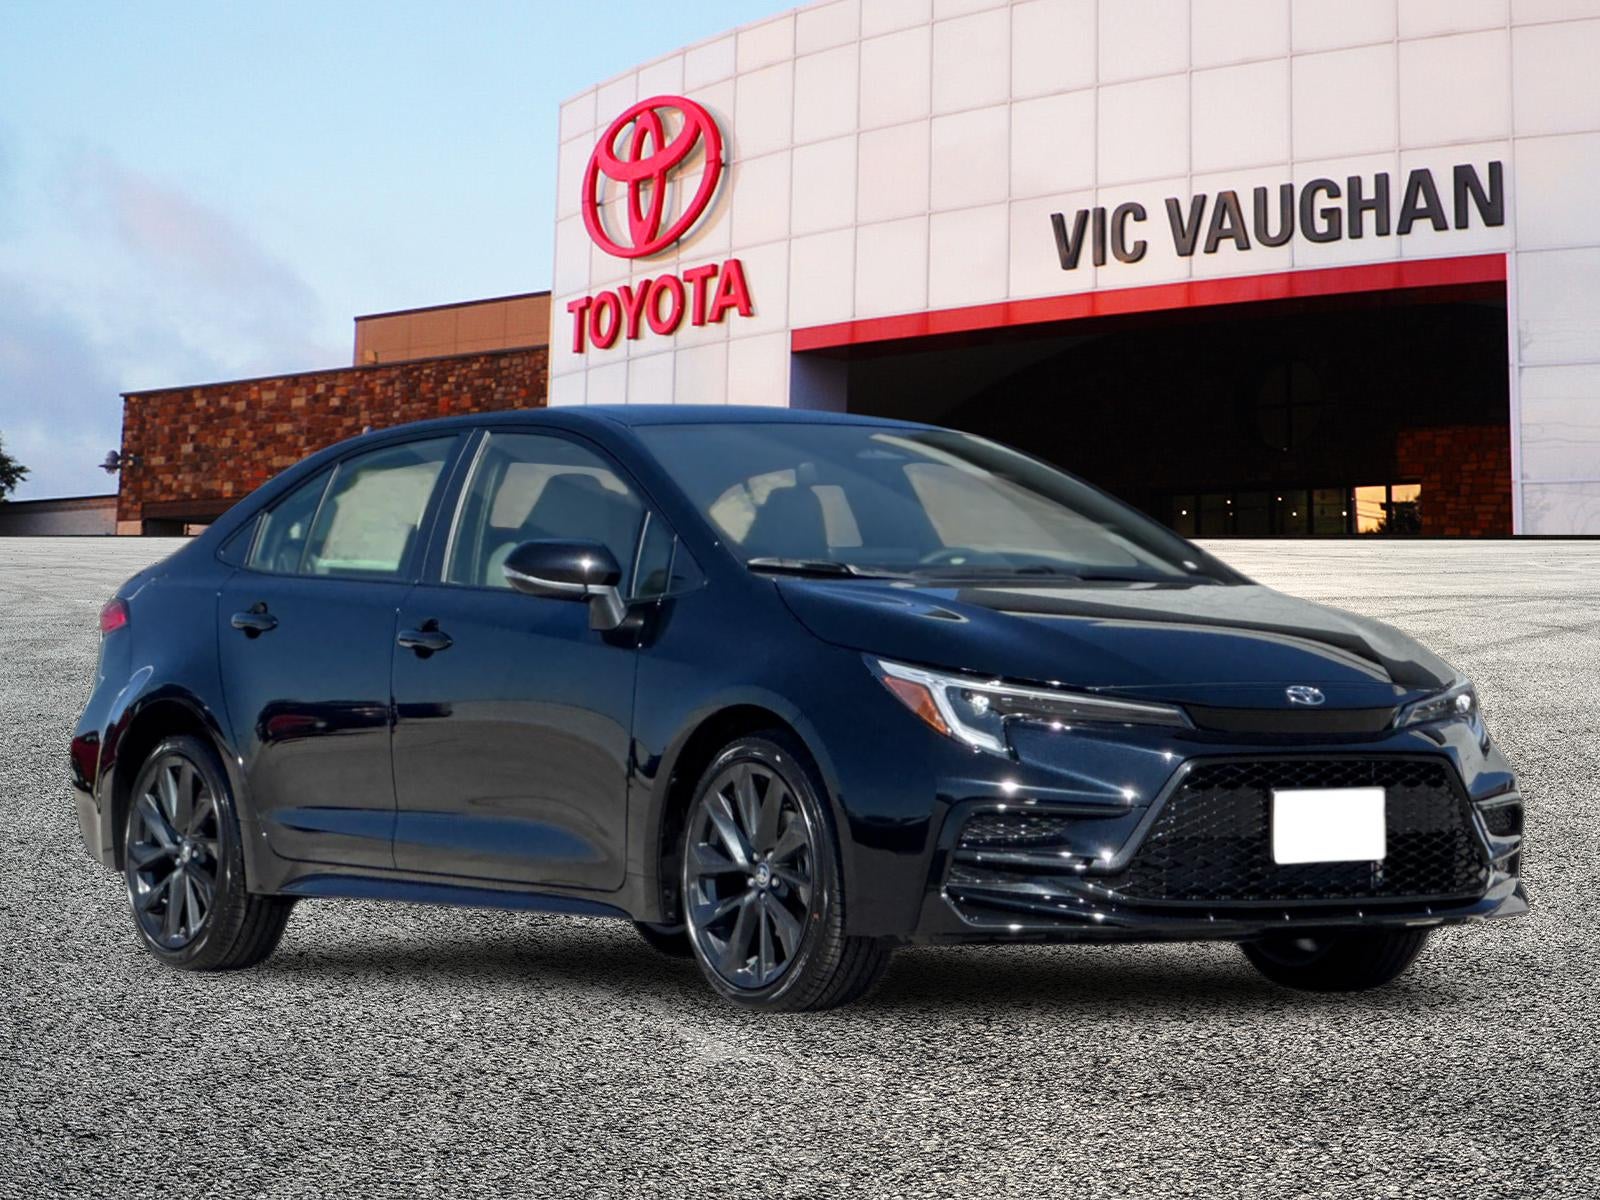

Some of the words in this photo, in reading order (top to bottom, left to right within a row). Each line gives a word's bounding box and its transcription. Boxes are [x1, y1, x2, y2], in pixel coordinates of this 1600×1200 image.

[1050, 201, 1148, 271] VIC
[1164, 160, 1505, 258] VAUGHAN
[566, 259, 754, 354] TOYOTA
